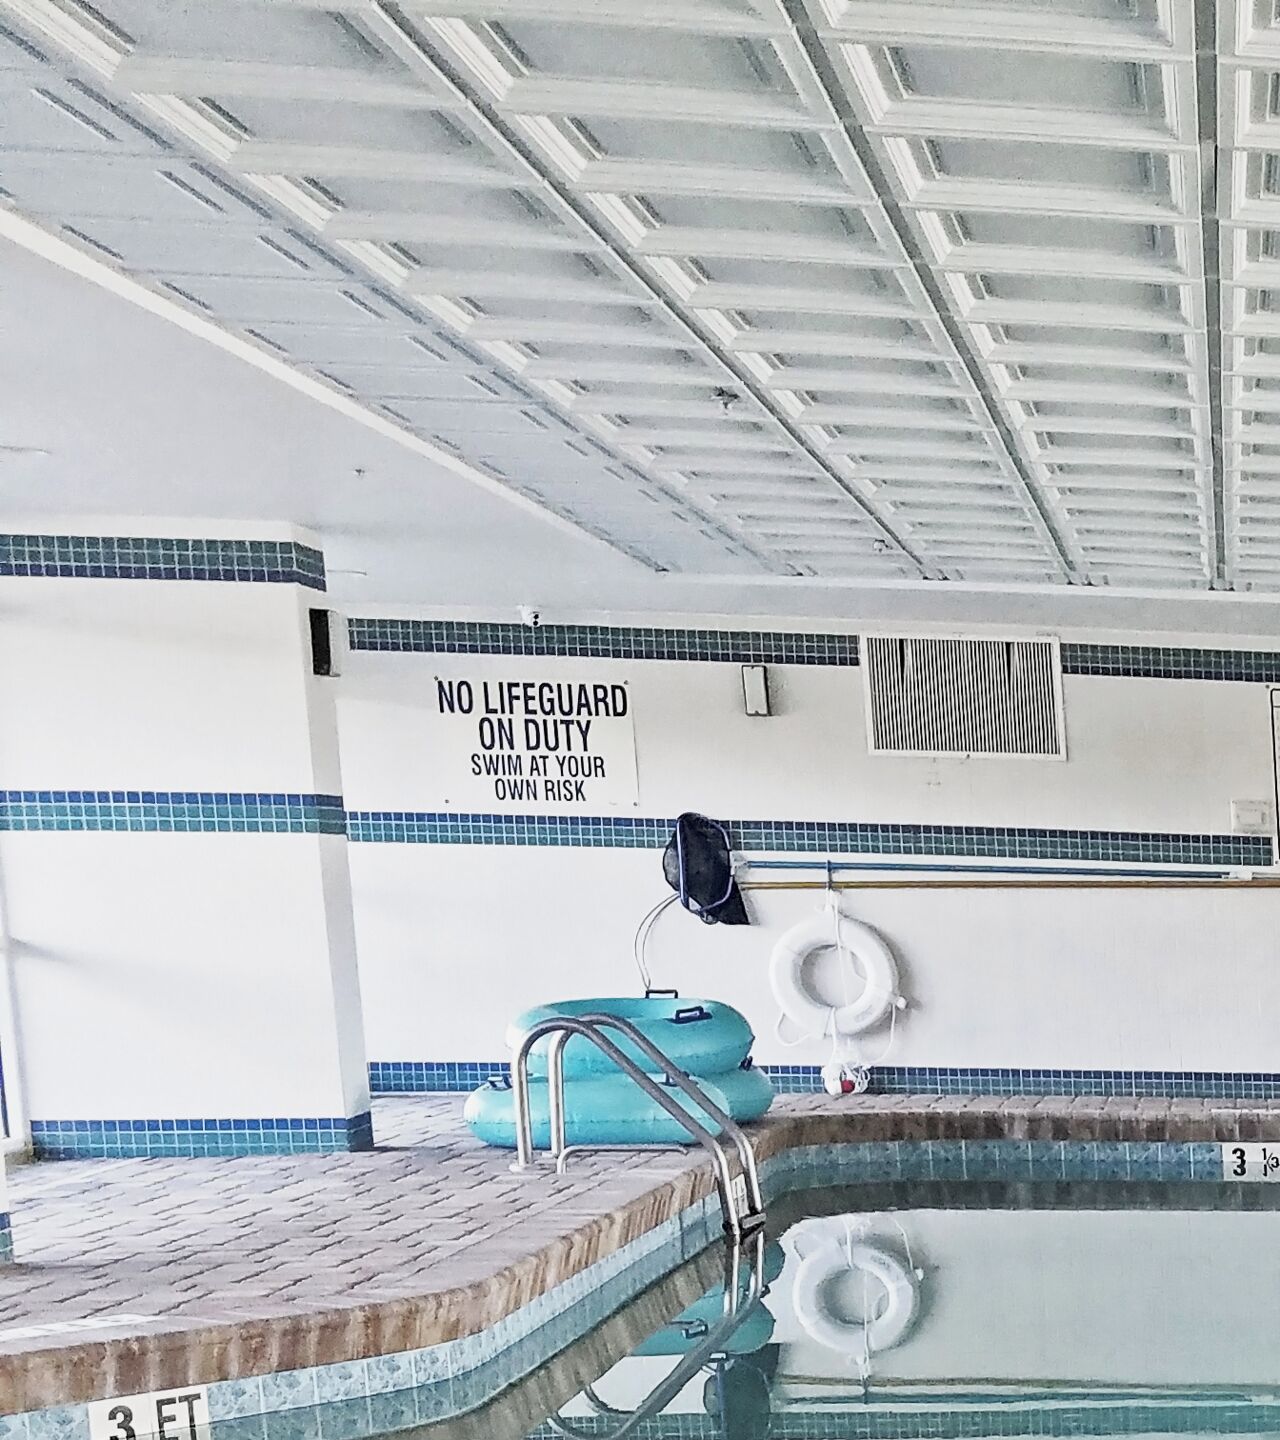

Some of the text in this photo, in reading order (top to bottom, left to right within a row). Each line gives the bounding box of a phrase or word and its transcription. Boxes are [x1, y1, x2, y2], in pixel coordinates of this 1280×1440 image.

[437, 680, 628, 717] NO LIFEGUARD
[479, 717, 591, 752] ON DUTY
[471, 753, 606, 778] SWIM AT YOUR
[495, 778, 586, 801] OWN RISK
